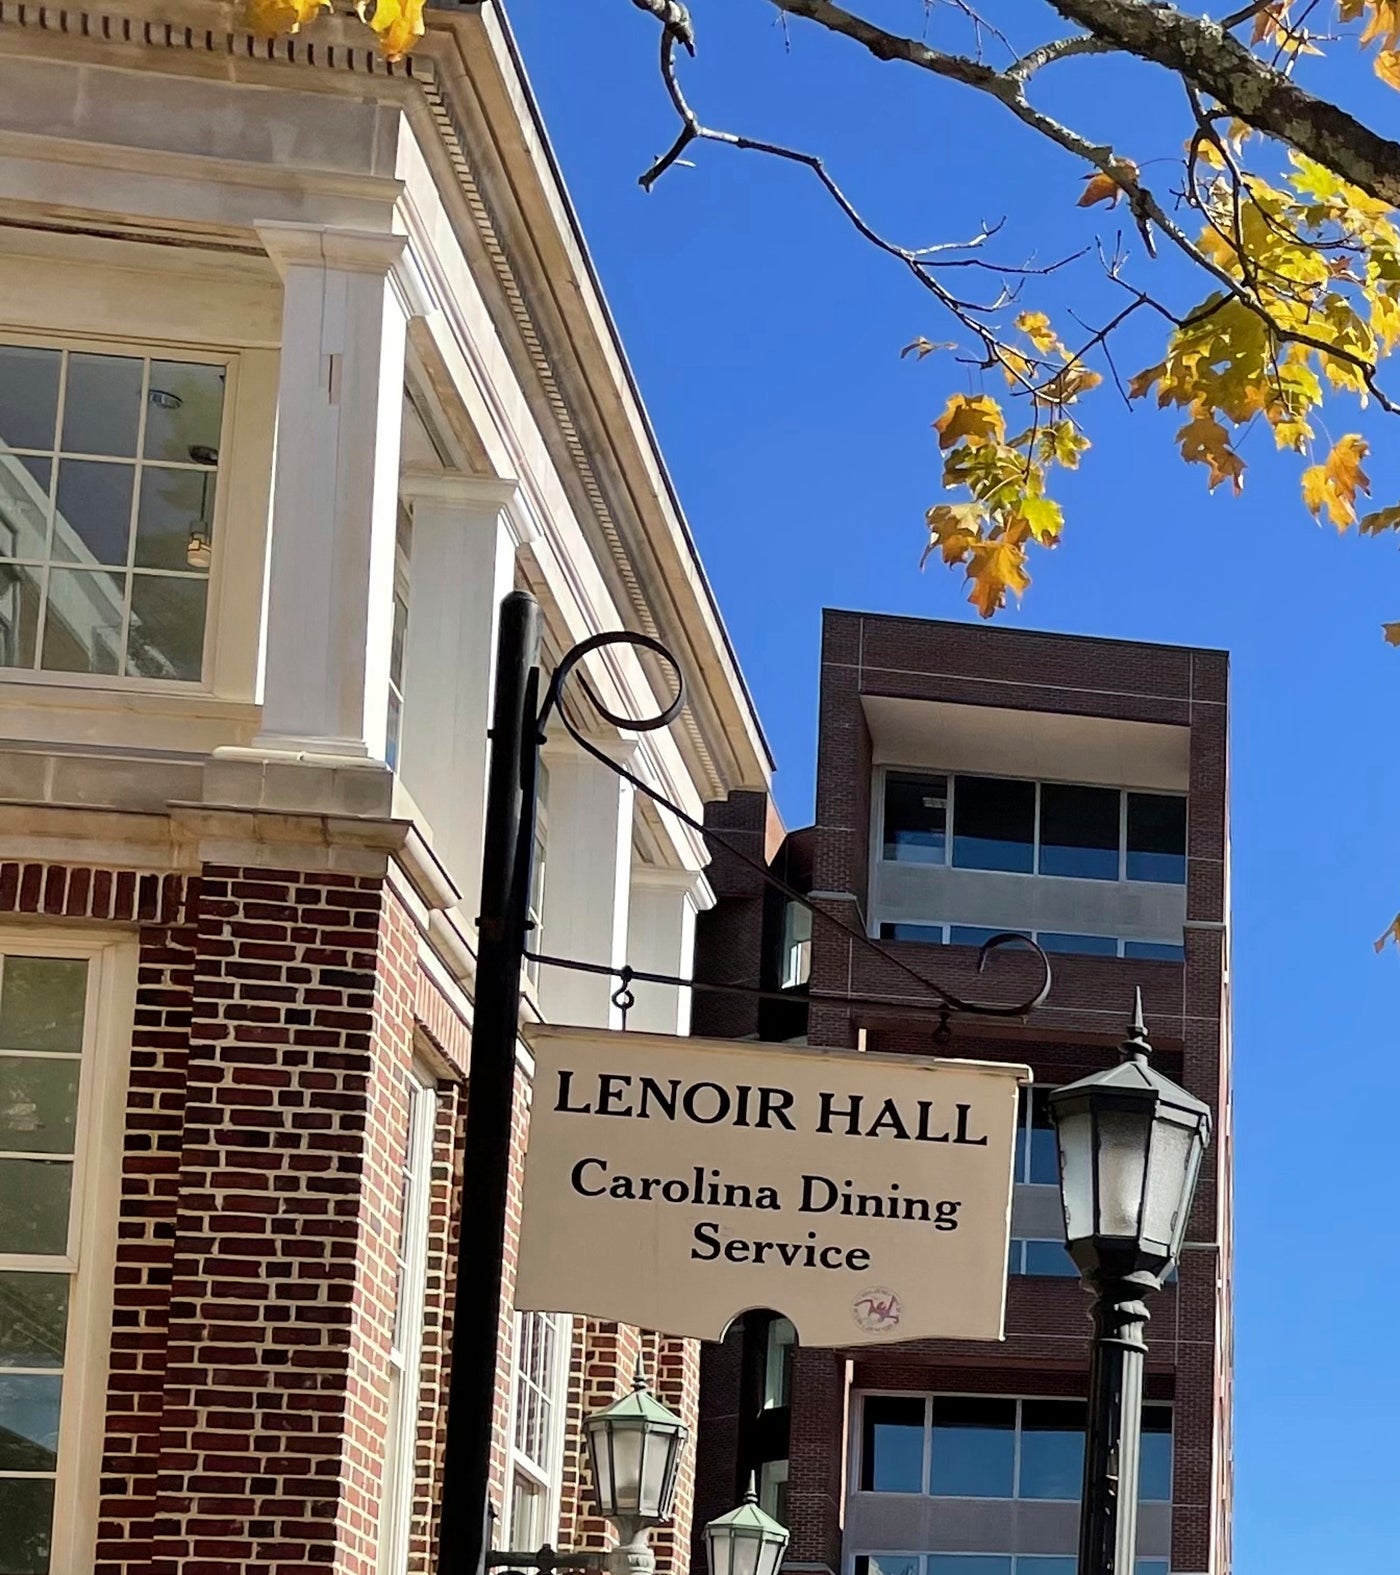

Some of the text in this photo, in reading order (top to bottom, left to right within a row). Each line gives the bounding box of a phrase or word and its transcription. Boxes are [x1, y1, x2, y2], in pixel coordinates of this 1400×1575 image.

[554, 1070, 989, 1147] LENOIR HALL
[571, 1158, 962, 1232] Carolina Dining
[690, 1222, 871, 1271] Service
